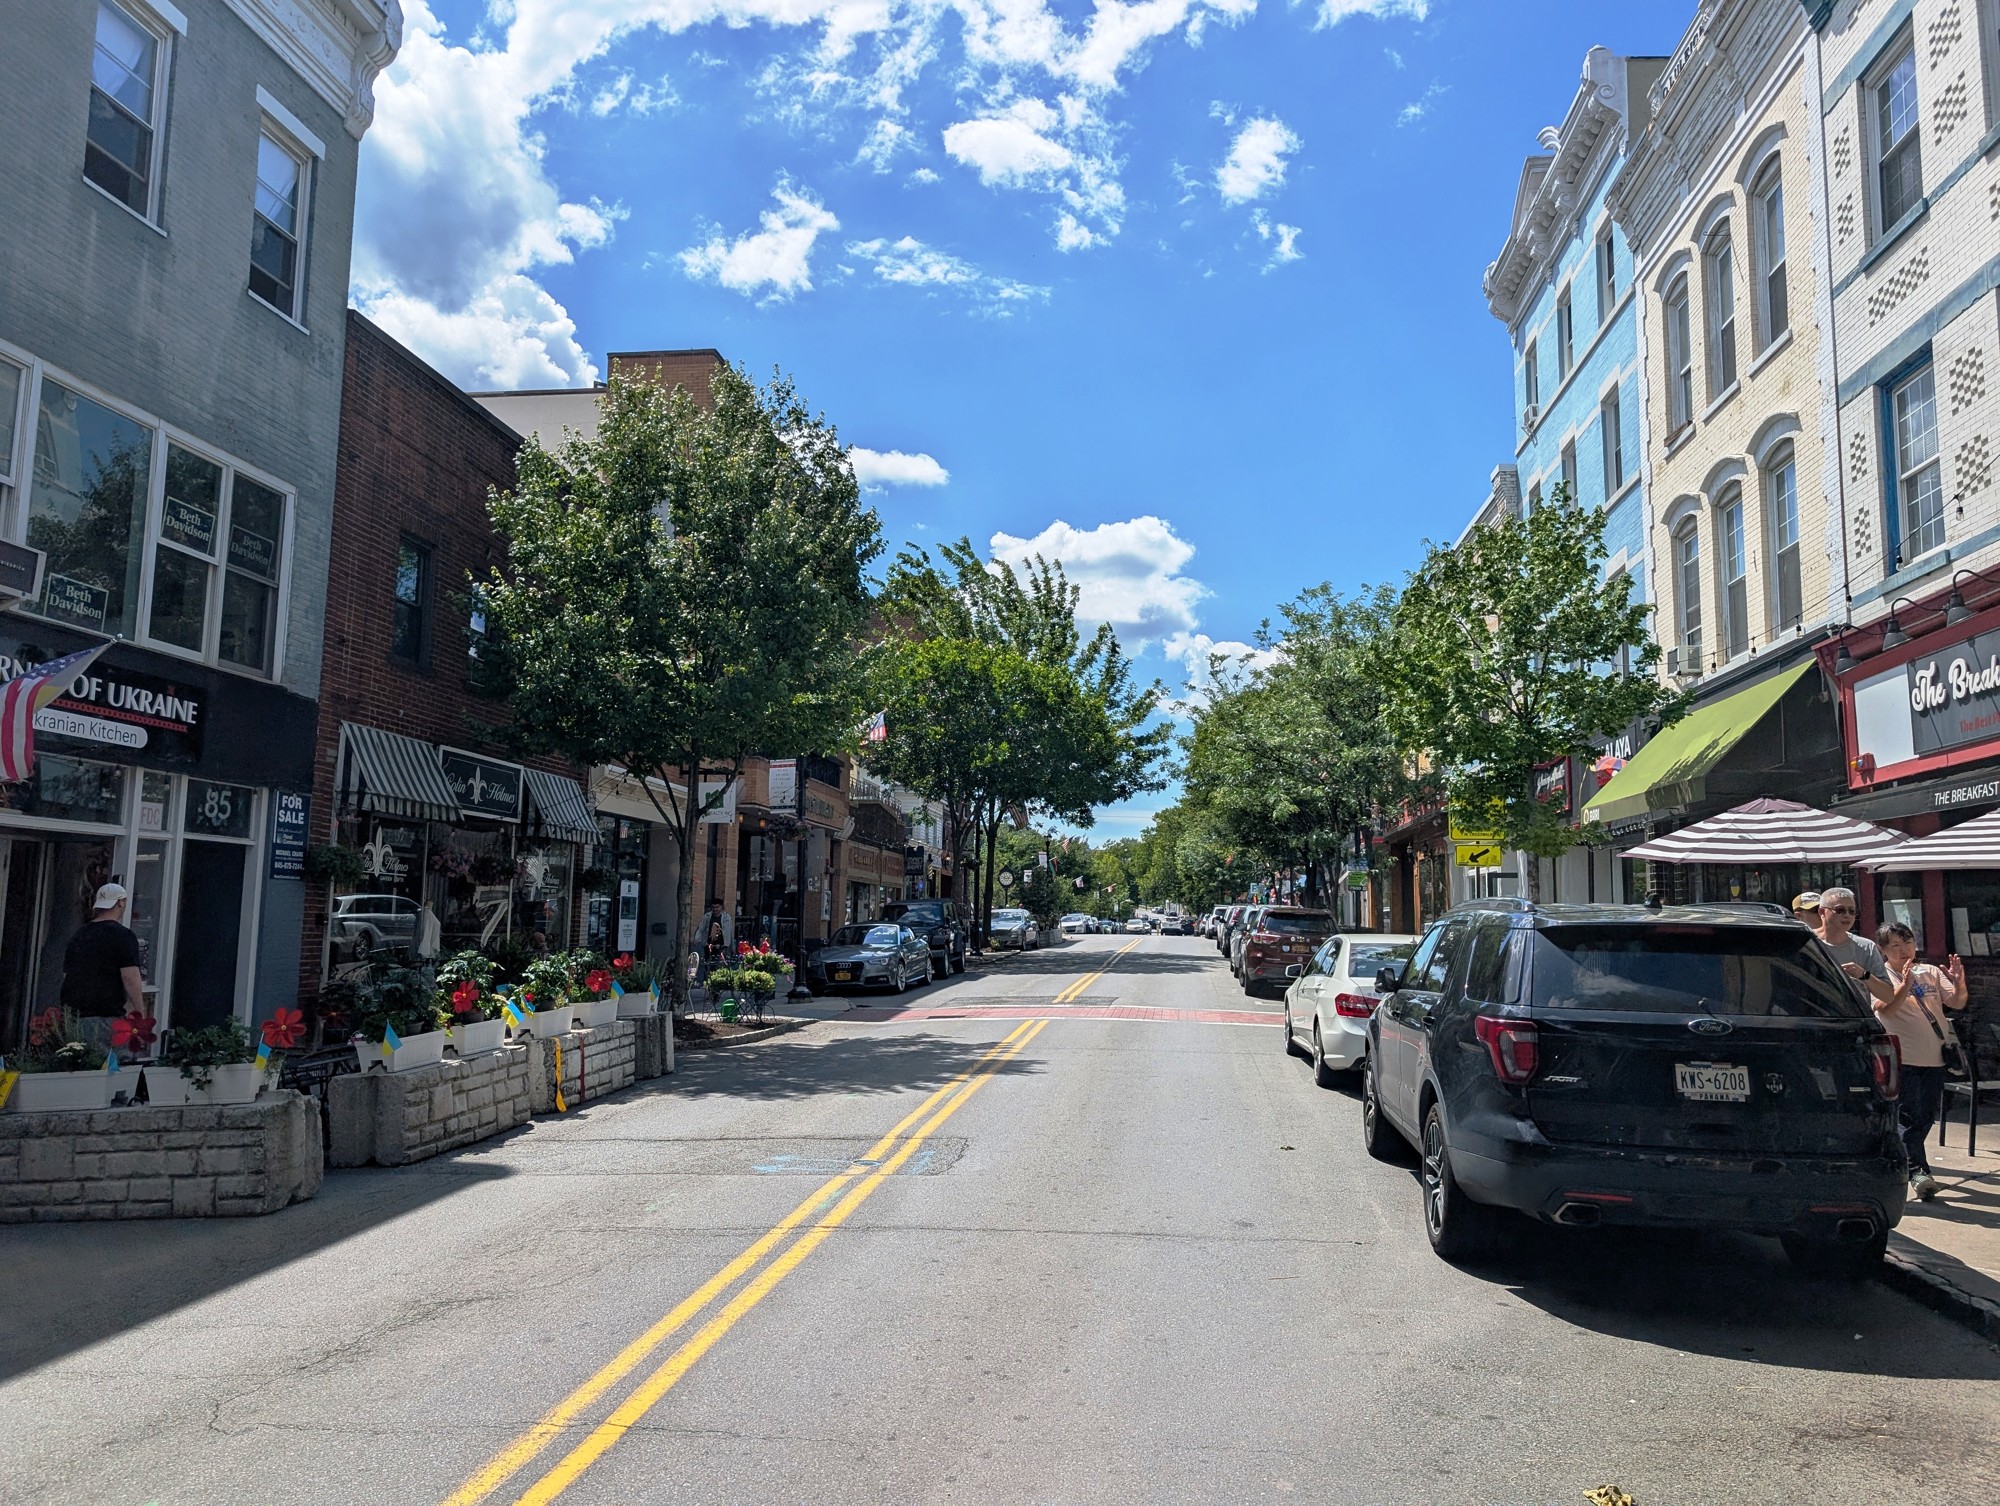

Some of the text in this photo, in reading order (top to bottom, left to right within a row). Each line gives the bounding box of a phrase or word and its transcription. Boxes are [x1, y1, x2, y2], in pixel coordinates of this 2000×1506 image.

[179, 508, 201, 525] Beth
[166, 515, 210, 541] Davidson
[231, 542, 268, 565] Davidson
[243, 536, 262, 551] Beth
[65, 585, 91, 603] Beth
[49, 594, 102, 619] Davidson
[1911, 661, 1947, 712] The
[68, 675, 103, 701] OF
[107, 682, 198, 724] UKRAINE
[34, 713, 137, 745] kranian Kitchen
[204, 788, 232, 820] 85
[281, 795, 303, 810] FOR
[486, 783, 516, 804] Holmes
[1934, 780, 2000, 806] THE BREAKFAST
[278, 809, 305, 825] SALE
[1699, 1021, 1722, 1032] Ford
[1699, 1093, 1730, 1101] PANAMA
